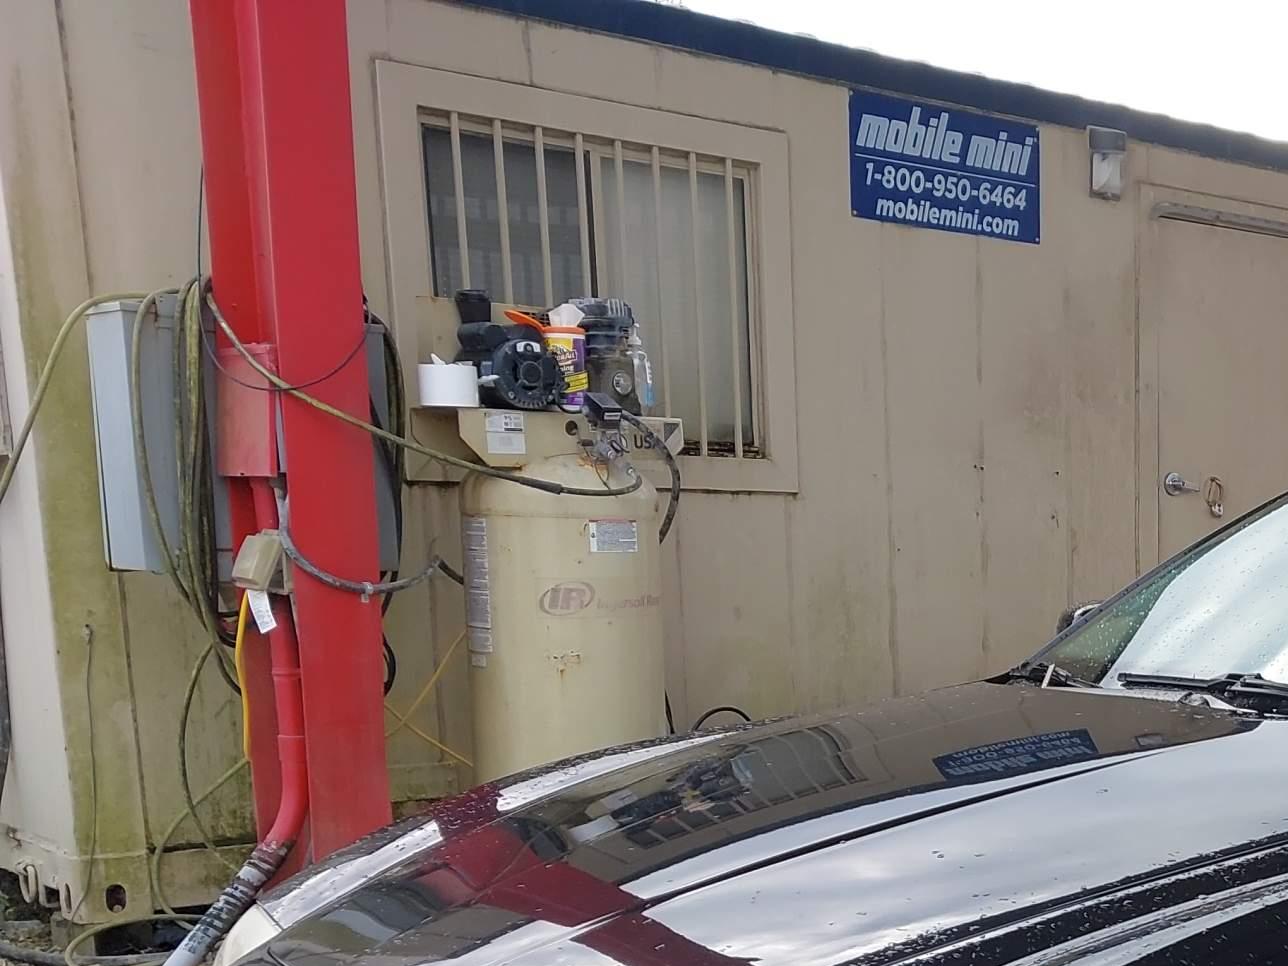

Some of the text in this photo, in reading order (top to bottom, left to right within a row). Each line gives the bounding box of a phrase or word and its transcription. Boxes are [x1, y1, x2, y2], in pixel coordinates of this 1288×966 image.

[856, 106, 1034, 176] mobile mini
[865, 162, 1027, 211] 1-800-950-6464
[876, 198, 1019, 236] mobilemini.com
[634, 433, 657, 449] US
